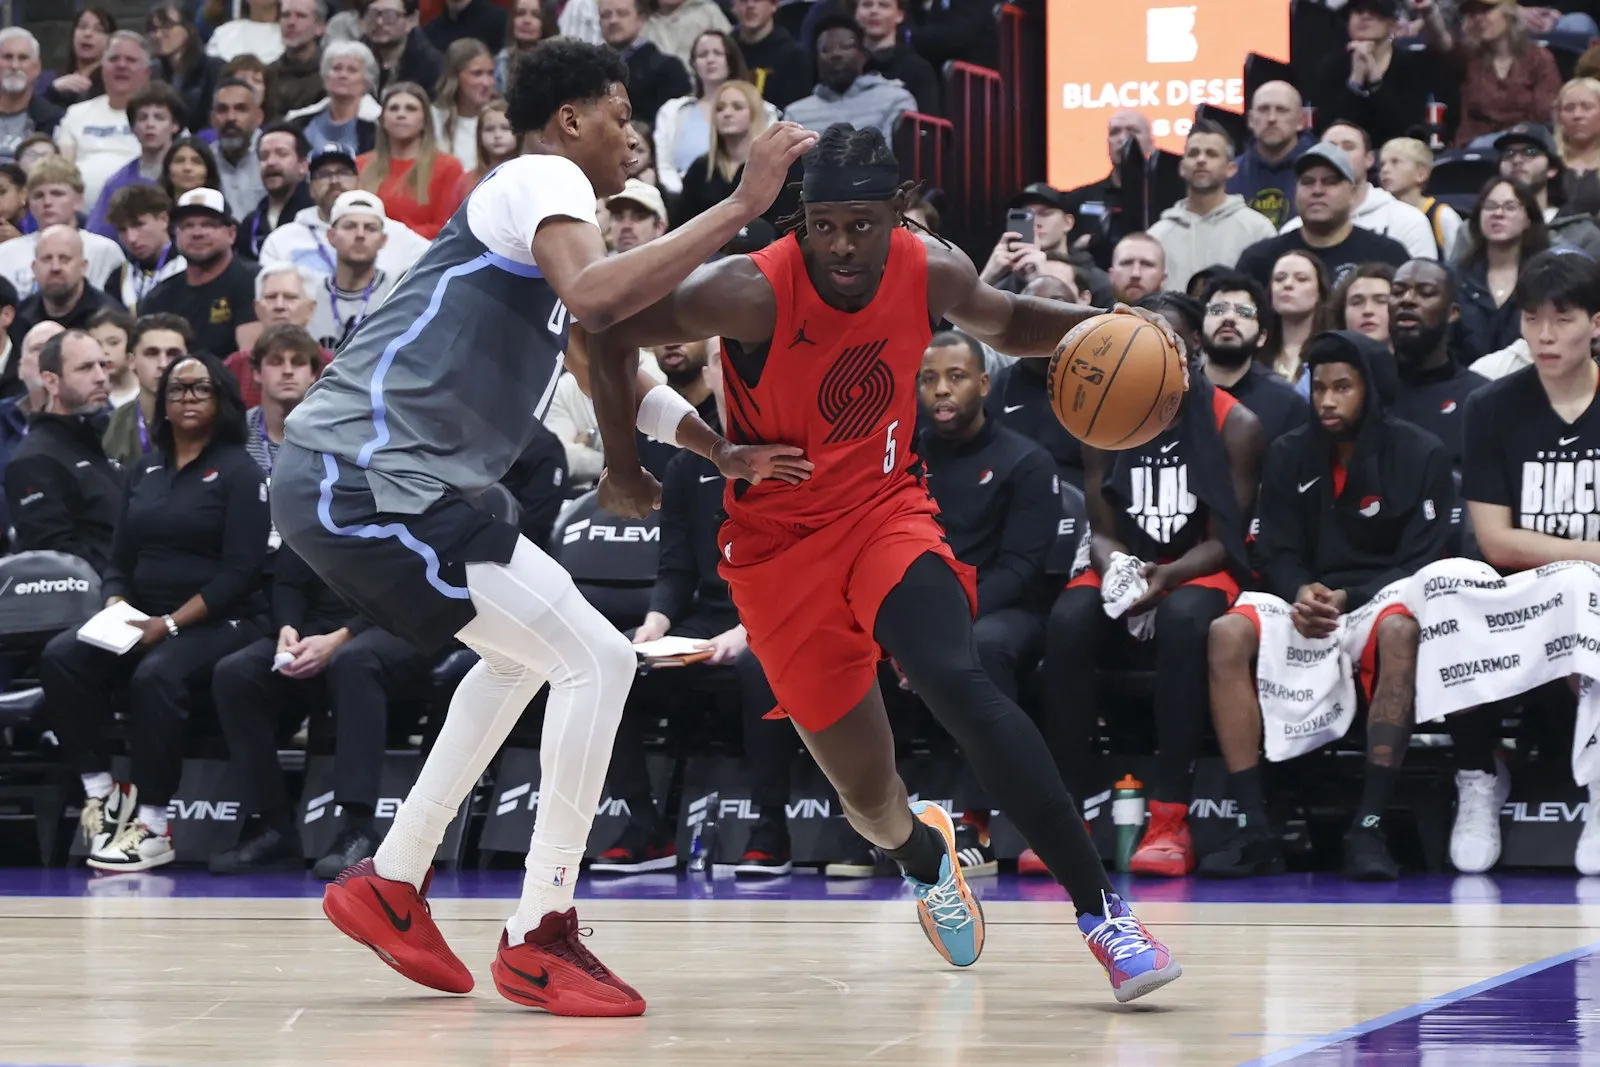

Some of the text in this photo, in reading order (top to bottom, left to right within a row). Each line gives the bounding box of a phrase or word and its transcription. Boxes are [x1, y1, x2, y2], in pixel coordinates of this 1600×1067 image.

[1063, 81, 1160, 109] BLACK
[883, 419, 899, 475] 5
[14, 576, 90, 595] entrata
[1485, 592, 1564, 628] BODYARMOR
[1439, 654, 1522, 683] BODYARMOR
